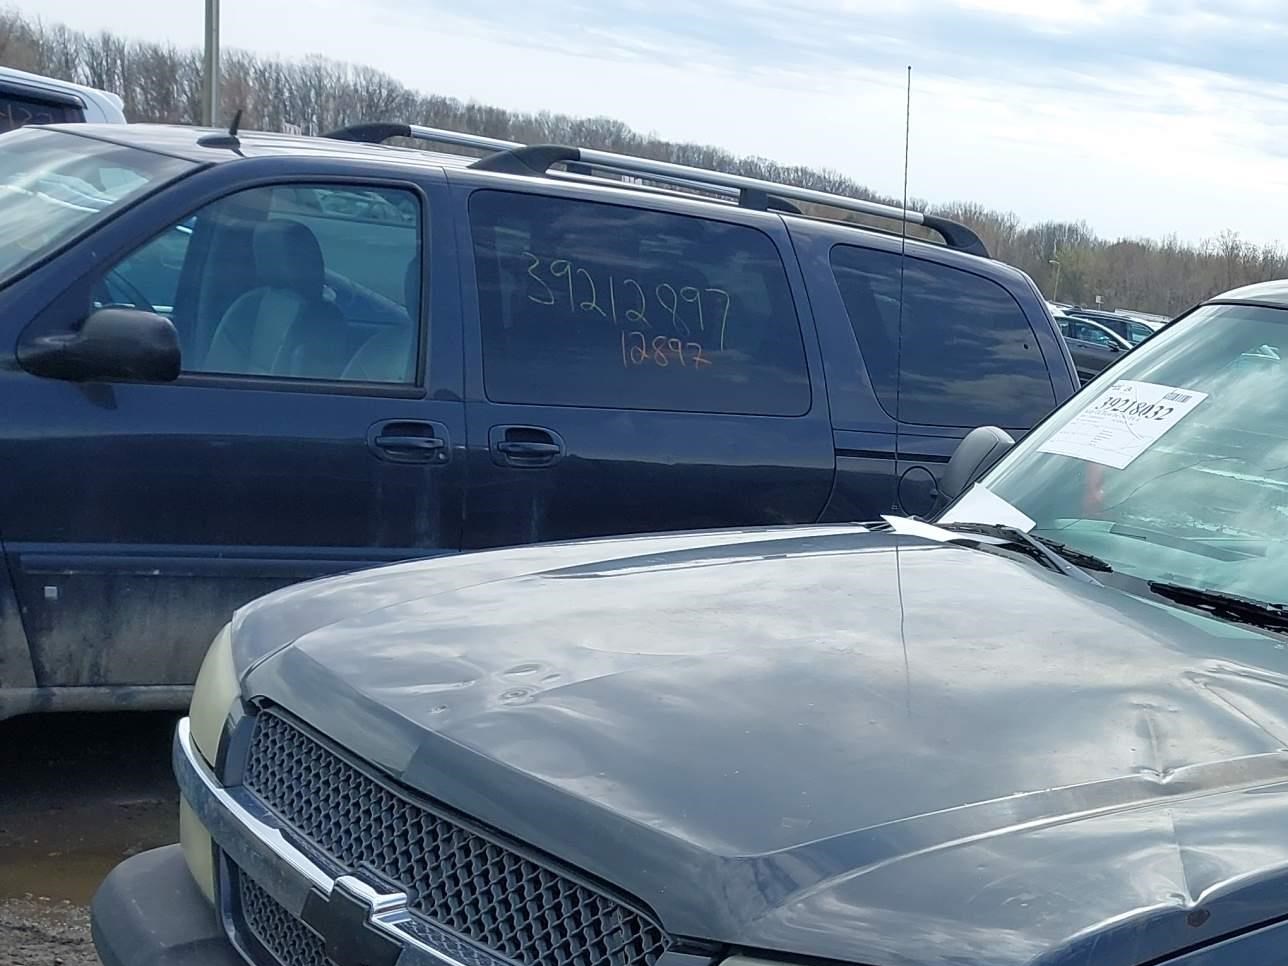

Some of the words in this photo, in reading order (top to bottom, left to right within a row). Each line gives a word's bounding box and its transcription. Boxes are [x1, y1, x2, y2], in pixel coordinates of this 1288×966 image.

[522, 251, 730, 352] 39212897
[621, 331, 712, 368] 12897
[1094, 396, 1175, 421] 39218032
